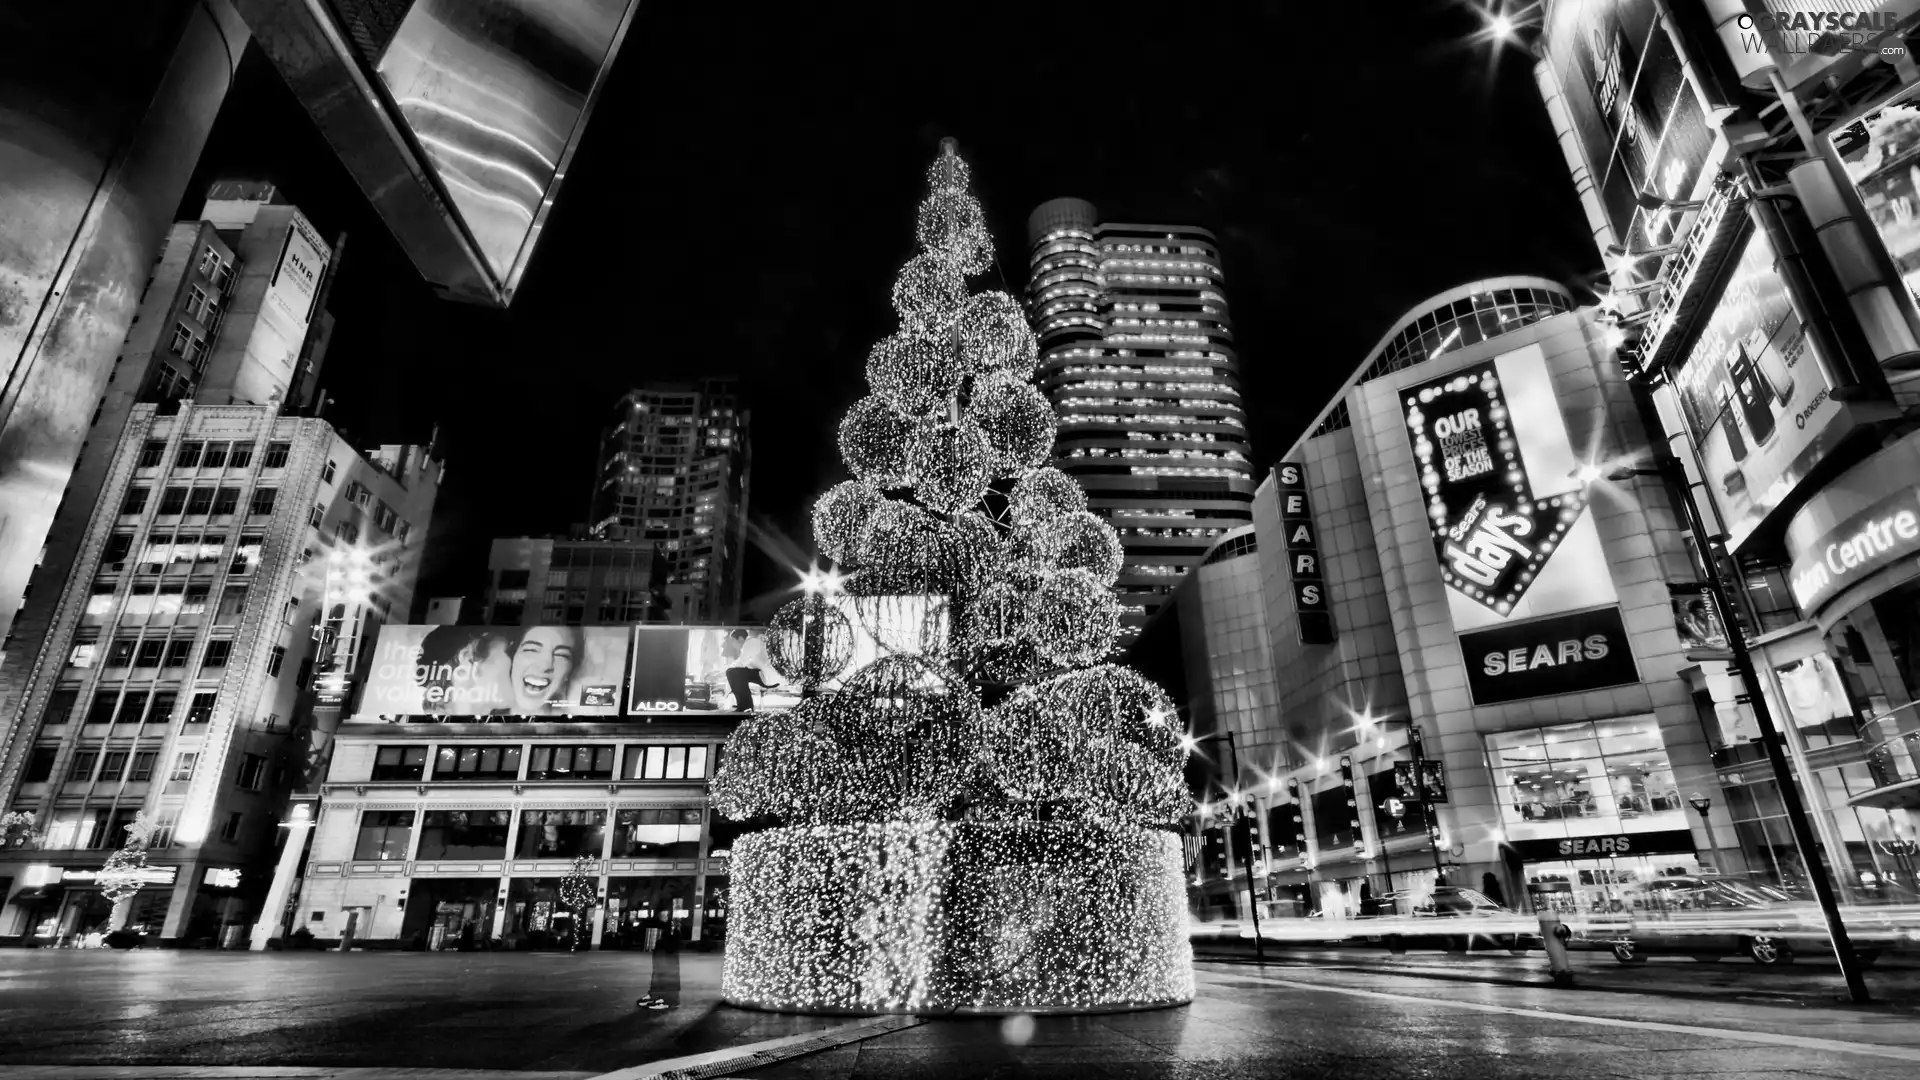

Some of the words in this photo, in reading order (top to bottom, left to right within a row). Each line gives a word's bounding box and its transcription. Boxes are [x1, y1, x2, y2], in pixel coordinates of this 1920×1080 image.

[291, 254, 313, 281] HNR
[1803, 388, 1828, 419] ROGERS
[1435, 408, 1481, 438] OUR
[1440, 427, 1483, 449] LOWEST
[1443, 437, 1487, 460] PRICES
[1445, 455, 1462, 471] OF
[1463, 448, 1490, 466] THE
[1447, 458, 1493, 482] SEASON
[1449, 498, 1486, 542] Sears
[1281, 466, 1320, 605] SEARS
[1446, 506, 1533, 587] days
[1826, 510, 1919, 575] Centre
[1700, 586, 1716, 621] DINING
[383, 640, 424, 661] the
[1483, 634, 1609, 676] SEARS
[379, 660, 481, 688] original
[636, 701, 679, 712] ALDO
[1559, 837, 1630, 855] SEARS
